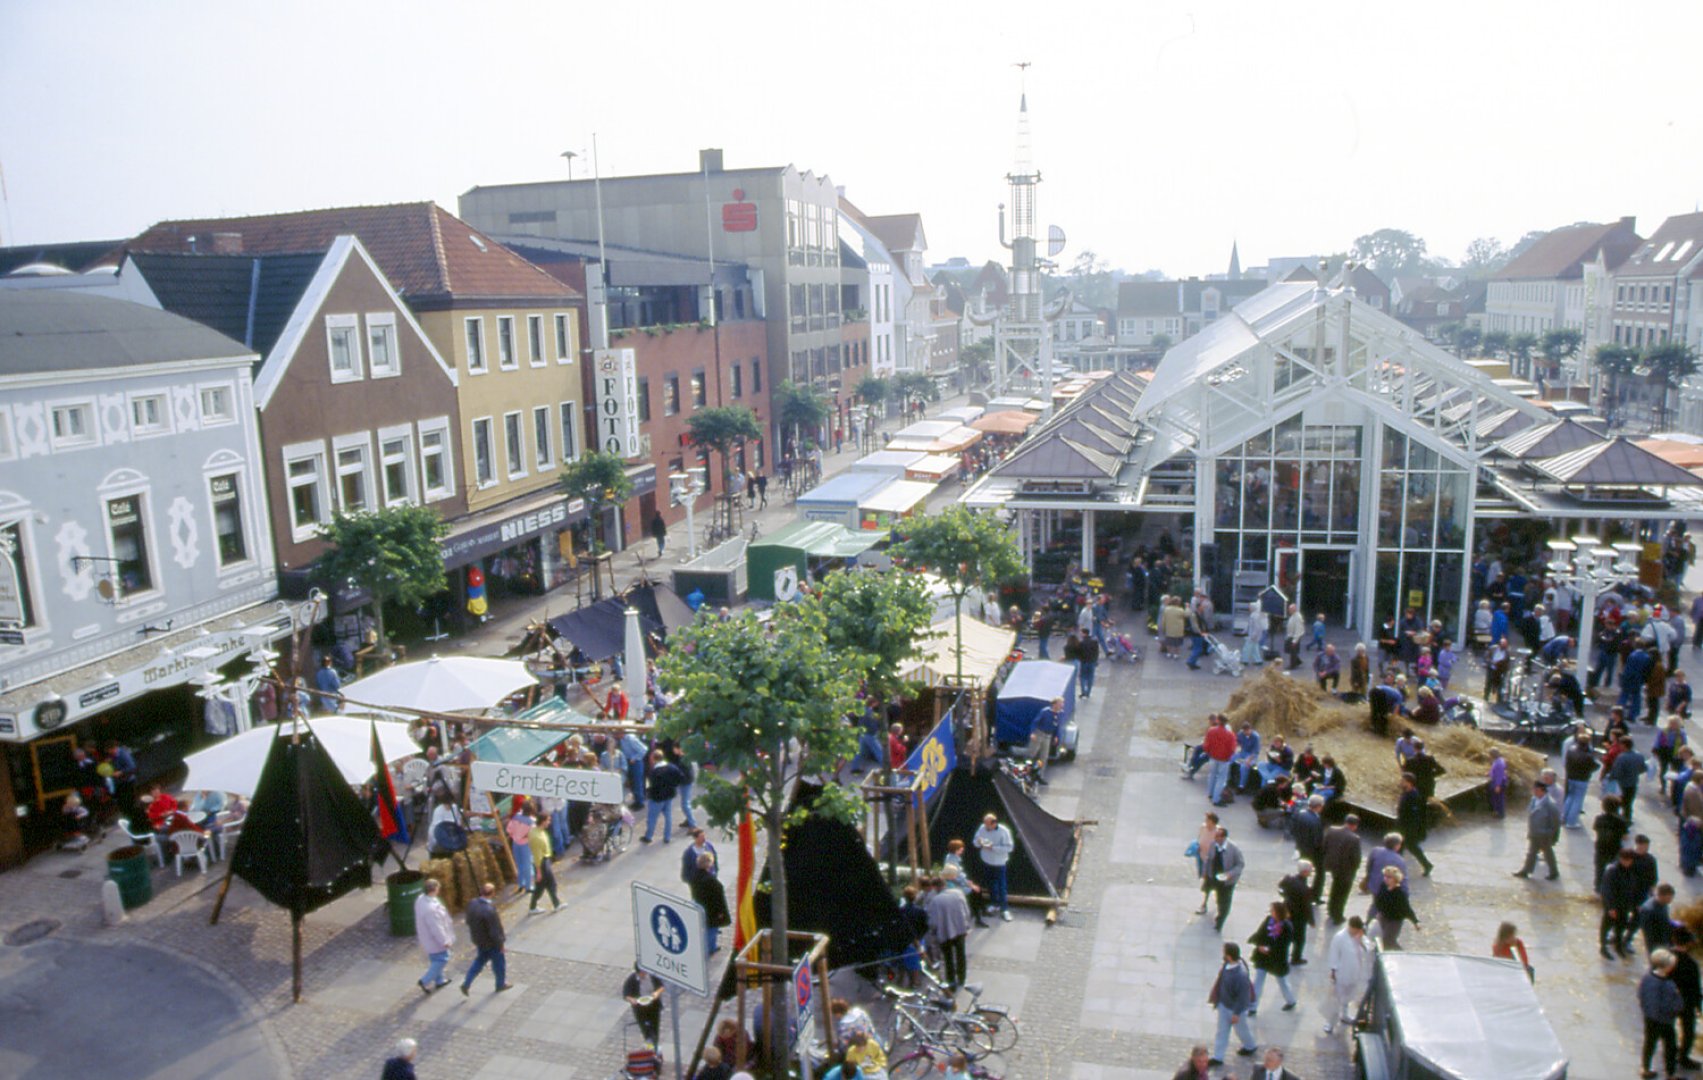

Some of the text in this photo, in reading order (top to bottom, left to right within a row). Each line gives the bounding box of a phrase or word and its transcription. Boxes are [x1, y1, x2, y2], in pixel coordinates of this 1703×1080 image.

[603, 377, 621, 454] FOTO
[626, 377, 638, 454] FOTO
[500, 505, 567, 542] NIESS
[494, 767, 602, 799] Erntefest
[655, 952, 689, 978] ZONE
